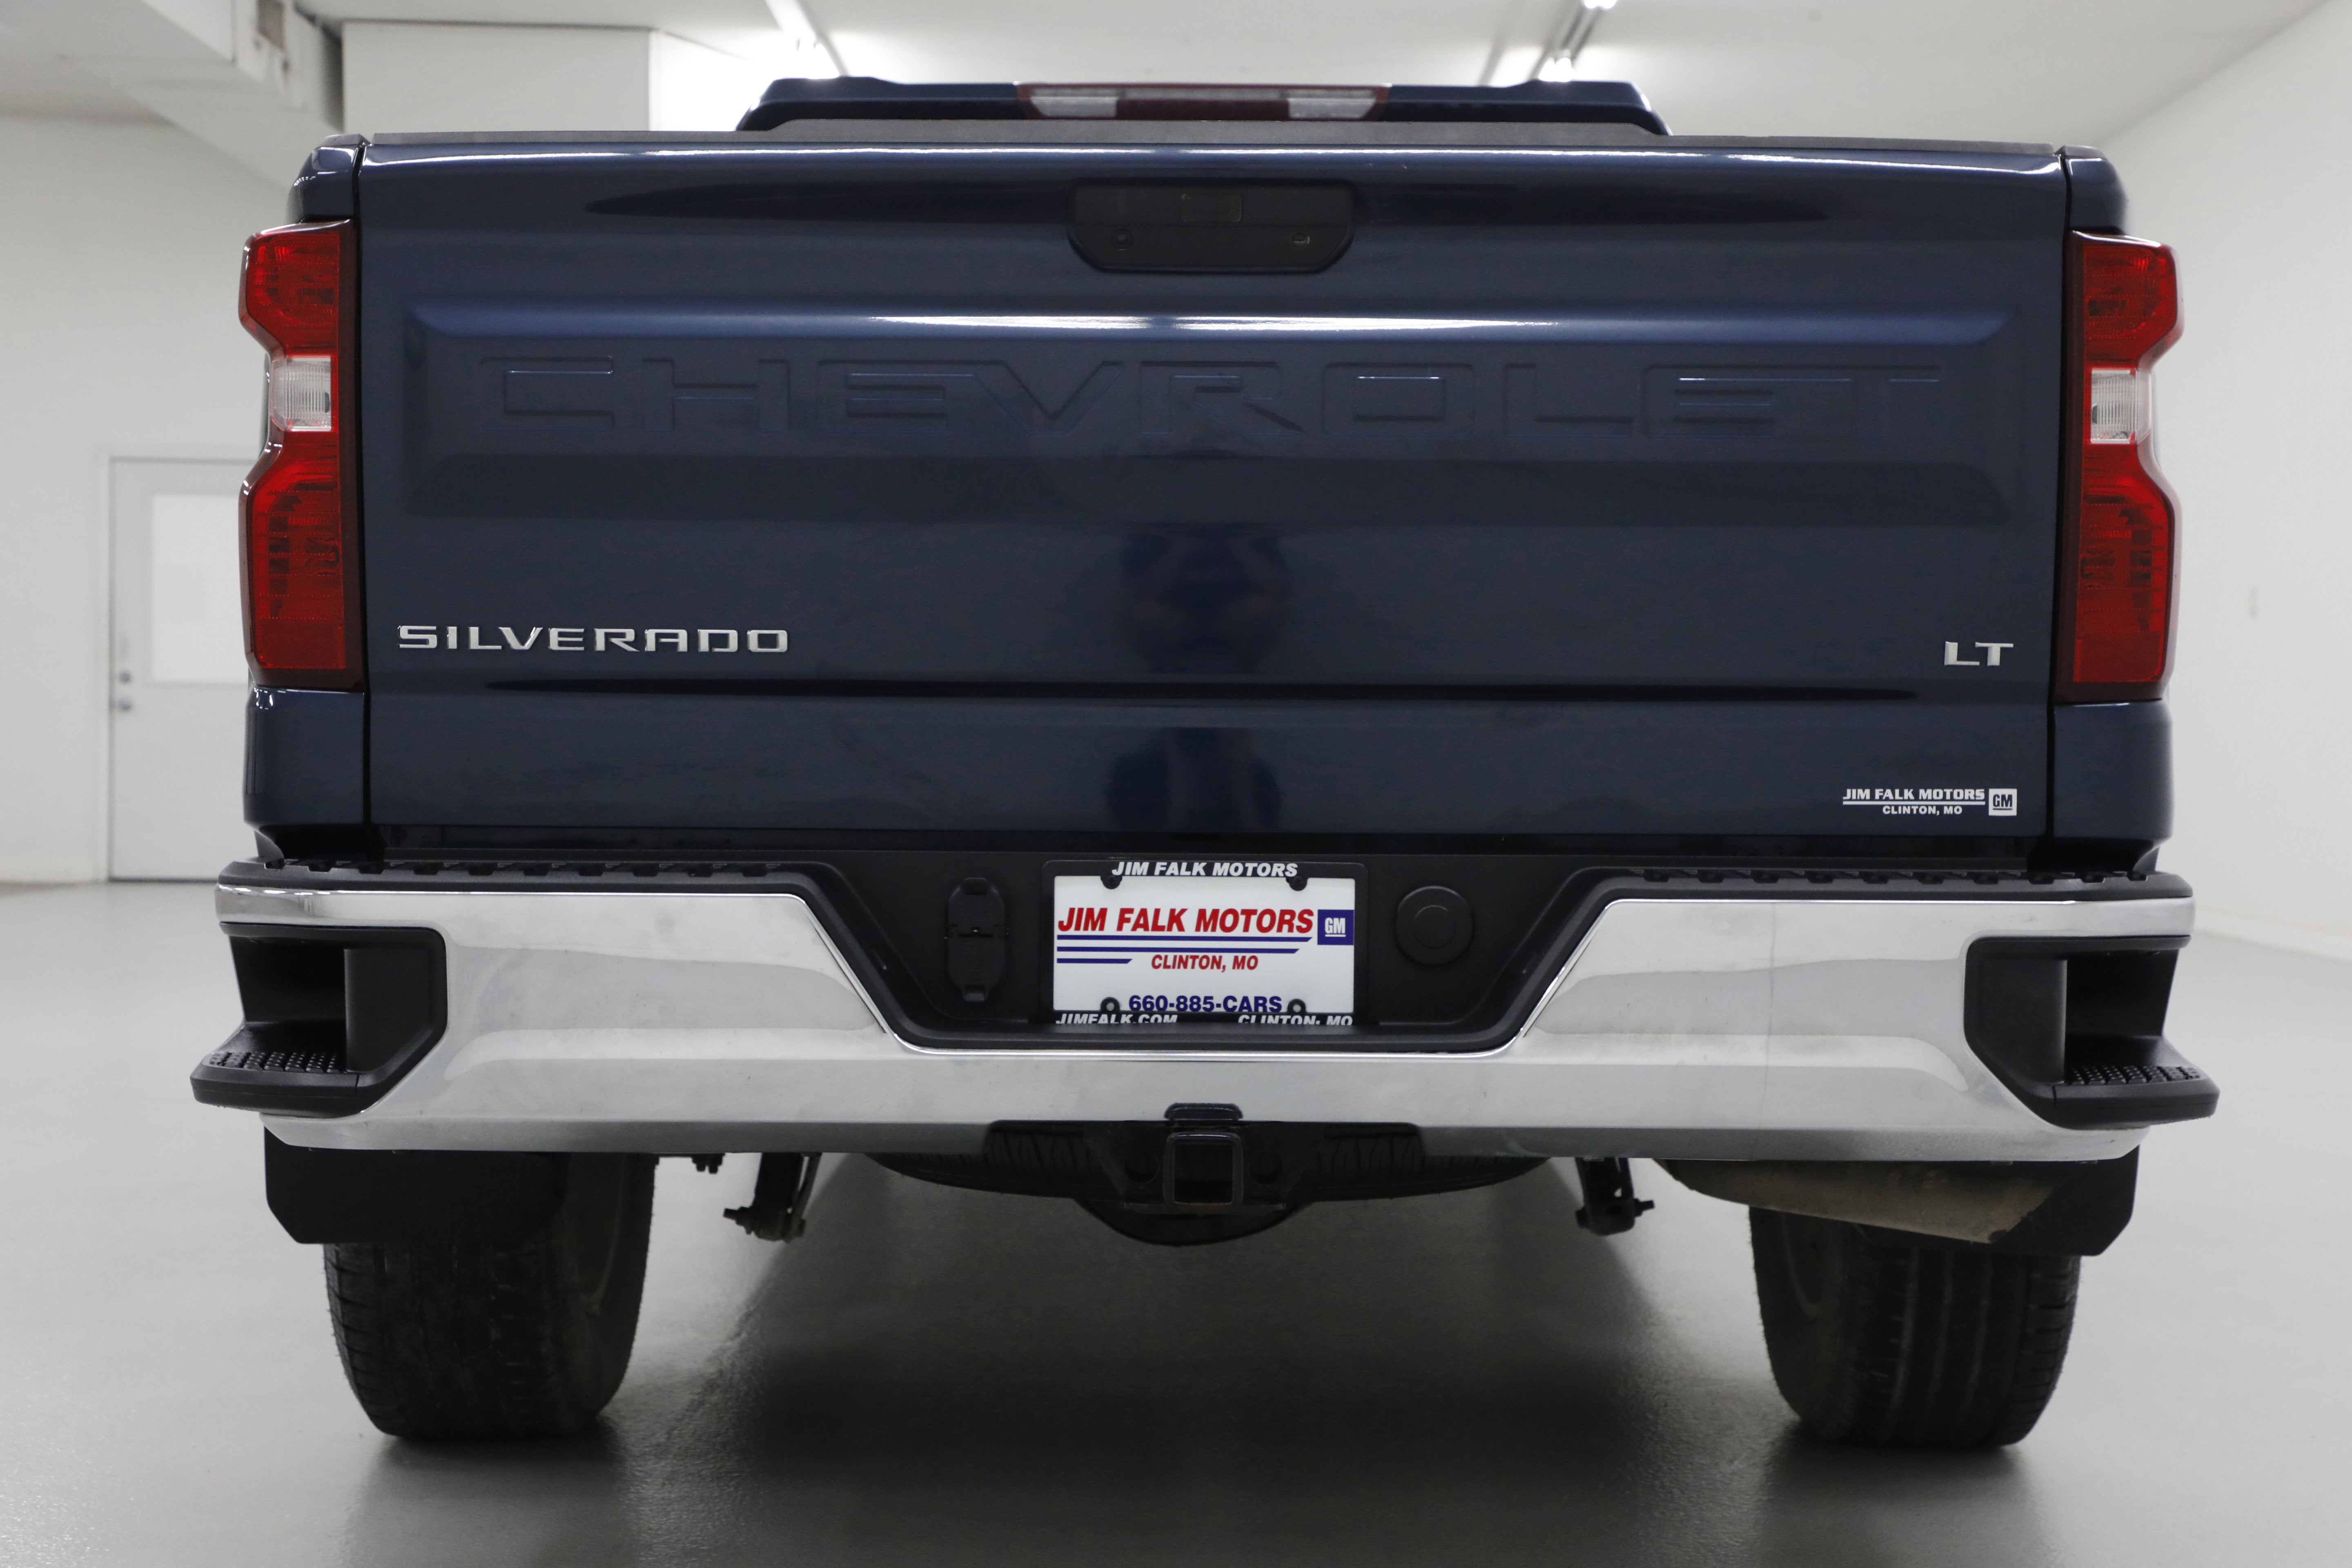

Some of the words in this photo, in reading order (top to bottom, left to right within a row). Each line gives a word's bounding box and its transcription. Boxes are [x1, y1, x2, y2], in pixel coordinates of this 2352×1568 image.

[479, 354, 1941, 442] CHEVROLET
[398, 625, 788, 653] SILVERADO
[1944, 641, 2013, 666] LT
[1843, 788, 1870, 800] JIM
[1875, 788, 1915, 800] FALK
[1919, 788, 1984, 800] MOTORS
[1993, 794, 2013, 807] GM
[1882, 806, 1940, 816] CLINTON,
[1944, 806, 1962, 815] MO
[1112, 862, 1149, 875] JIM
[1154, 862, 1207, 876] FALK
[1212, 862, 1298, 877] MOTORS
[1058, 907, 1108, 932] JIM
[1116, 907, 1188, 932] FALK
[1195, 909, 1314, 933] MOTORS
[1324, 917, 1346, 934] GM
[1151, 955, 1226, 972] CLINTON,
[1232, 956, 1258, 970] MO
[1129, 995, 1282, 1012] 660-885-CARS
[1326, 1016, 1353, 1026] MO
